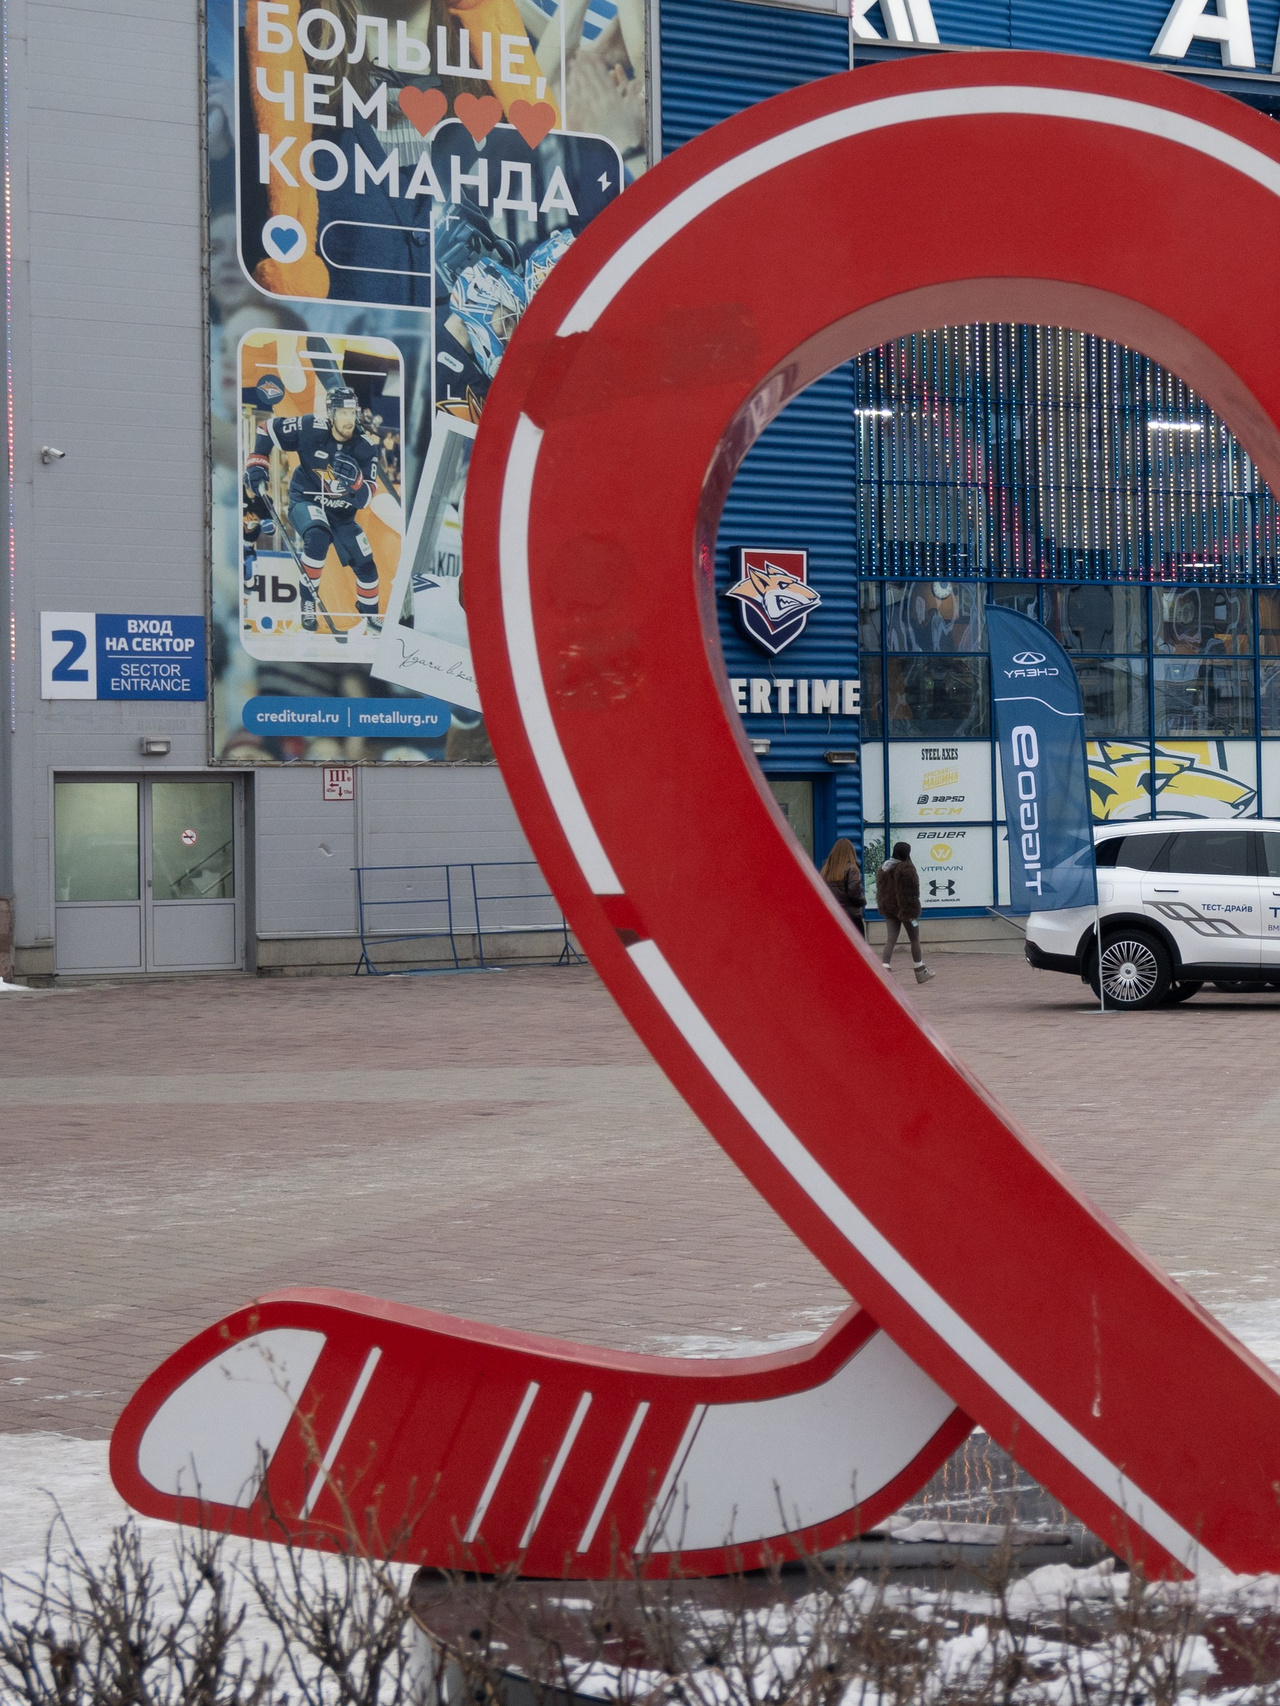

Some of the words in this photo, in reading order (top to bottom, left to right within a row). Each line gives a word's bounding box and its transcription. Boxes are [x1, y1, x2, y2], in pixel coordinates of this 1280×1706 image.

[256, 1, 548, 99] БОЛЬШЕ,
[255, 67, 388, 131] ЧЕМ
[258, 133, 579, 222] КОМАНДА
[127, 619, 173, 636] ВХОД
[105, 637, 129, 651] НА
[132, 637, 195, 652] СЕКТОР
[51, 629, 89, 682] 2
[120, 663, 181, 677] SECTOR
[110, 678, 191, 692] ENTRANCE
[256, 709, 340, 724] creditural.ru
[359, 711, 438, 727] metallurg.ru
[921, 747, 941, 761] STEEL
[941, 747, 959, 761] AXES
[918, 807, 964, 816] CCM
[1201, 903, 1253, 913] ТЕСТ-ДРАЙВ
